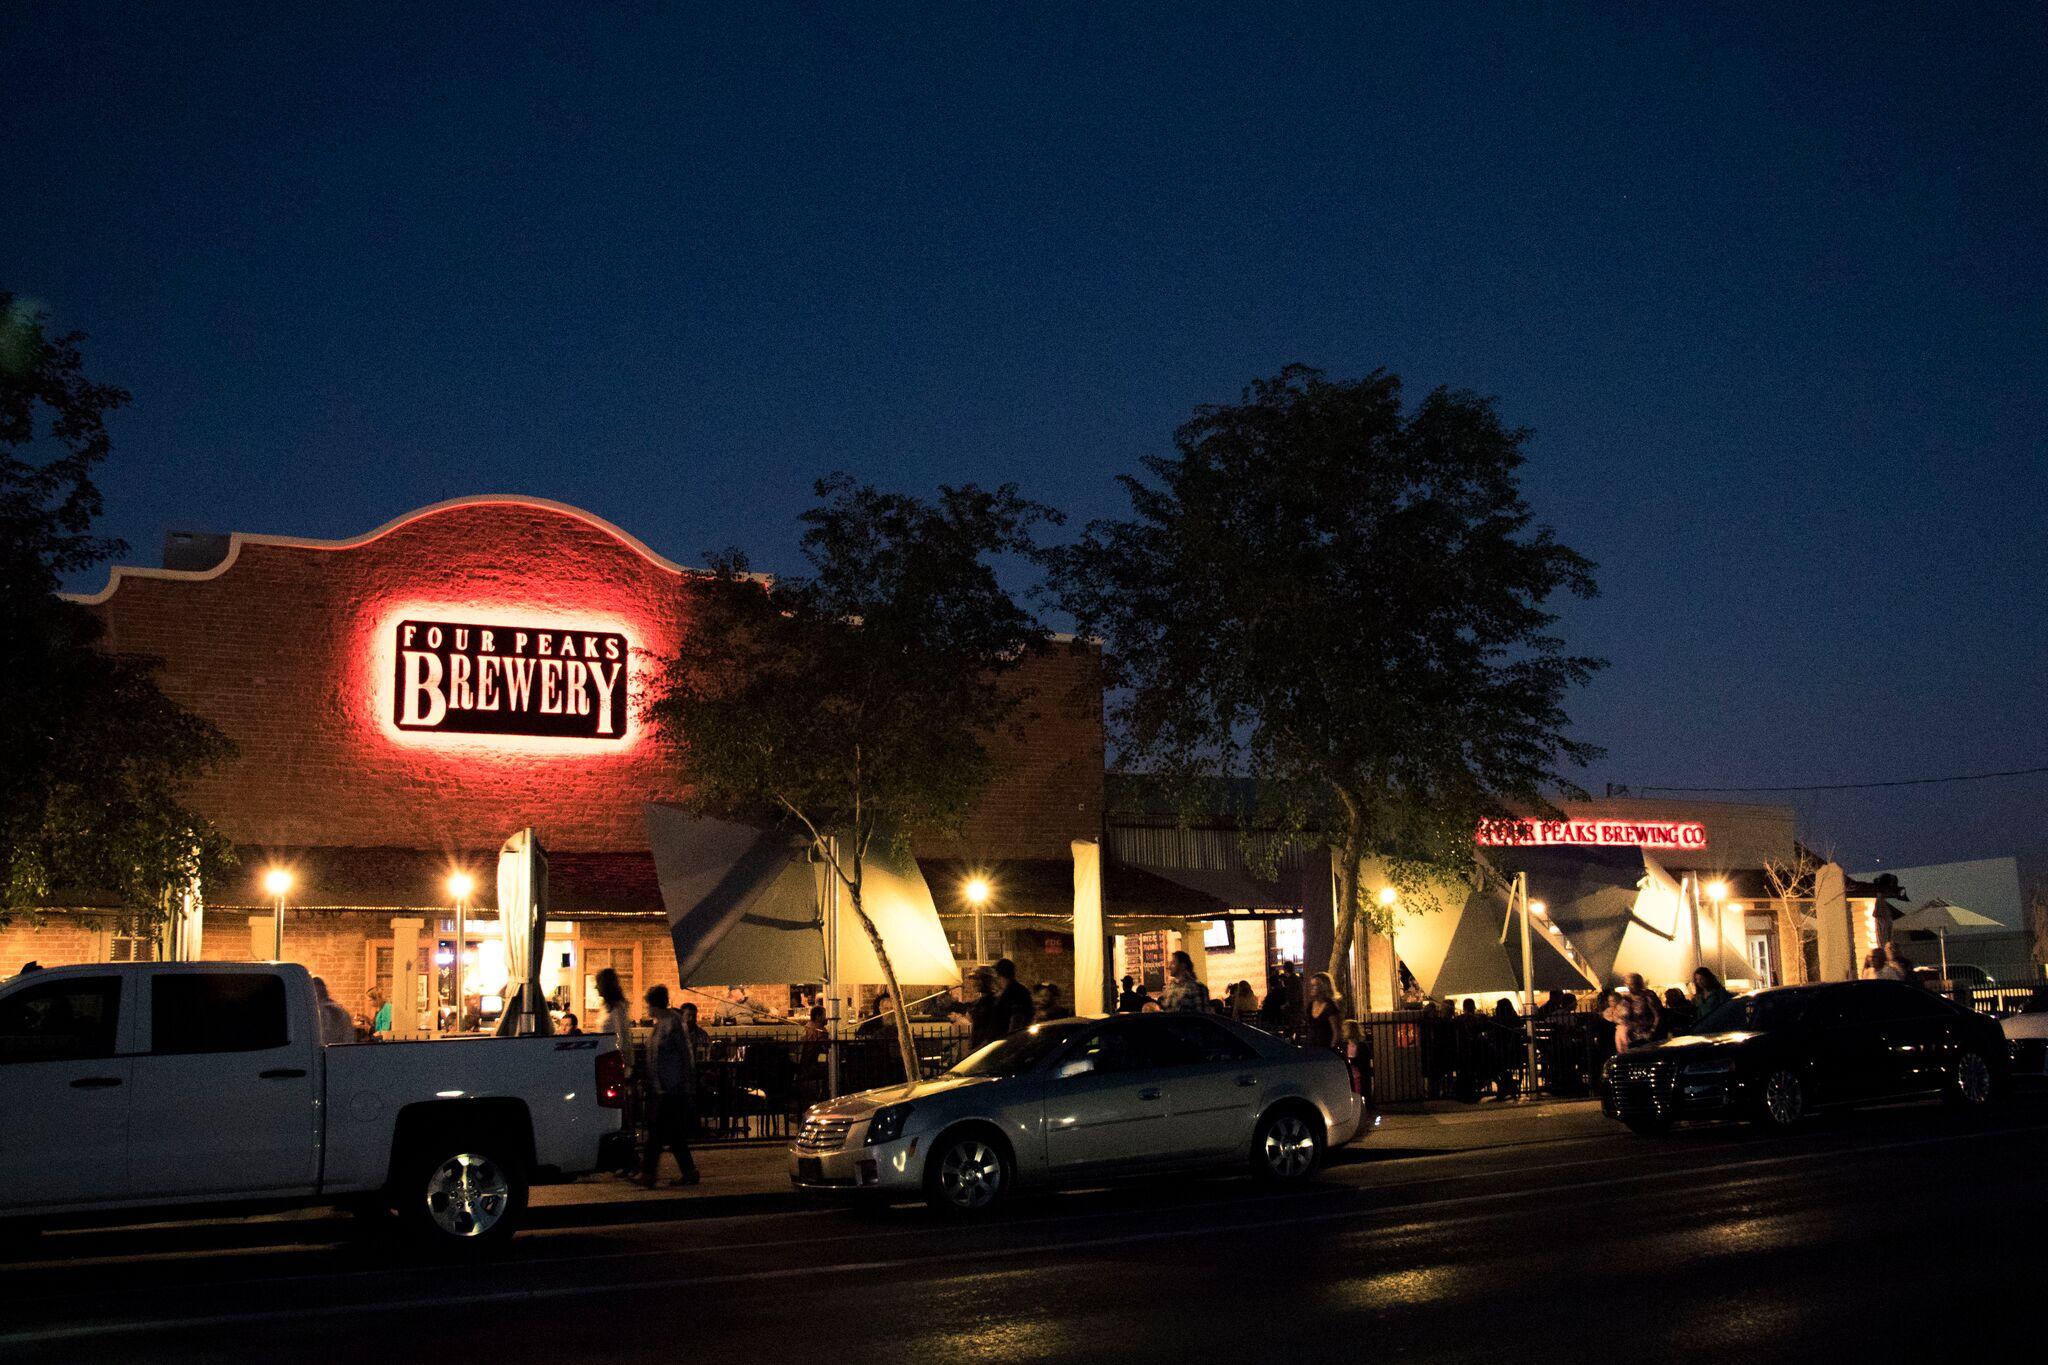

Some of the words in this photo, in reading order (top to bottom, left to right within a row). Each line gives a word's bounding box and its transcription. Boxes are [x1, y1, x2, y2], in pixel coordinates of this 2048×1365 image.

[403, 625, 495, 652] FOUR
[515, 632, 619, 659] PEAKS
[400, 651, 622, 733] BREWERY
[1541, 823, 1598, 842] PEAKS
[1602, 825, 1679, 843] BREWING
